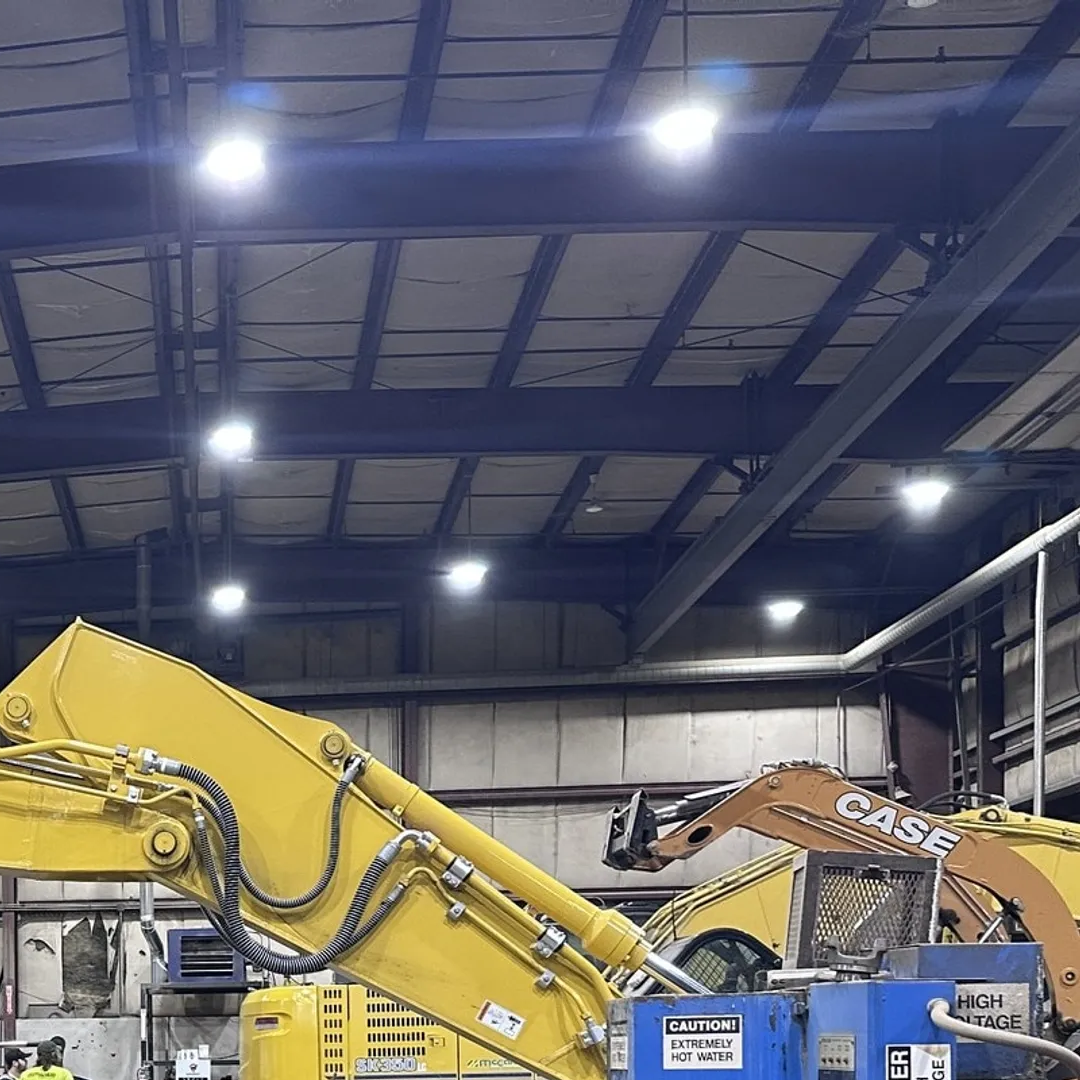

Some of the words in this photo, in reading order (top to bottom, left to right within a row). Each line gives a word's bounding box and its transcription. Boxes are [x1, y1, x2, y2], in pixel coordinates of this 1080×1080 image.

[835, 791, 963, 858] CASE
[958, 994, 1003, 1009] HIGH
[669, 1020, 736, 1032] CAUTION!
[955, 1015, 1022, 1030] LTAGE
[671, 1039, 733, 1050] EXTREMELY
[671, 1052, 693, 1062] HOT
[696, 1052, 733, 1062] WATER
